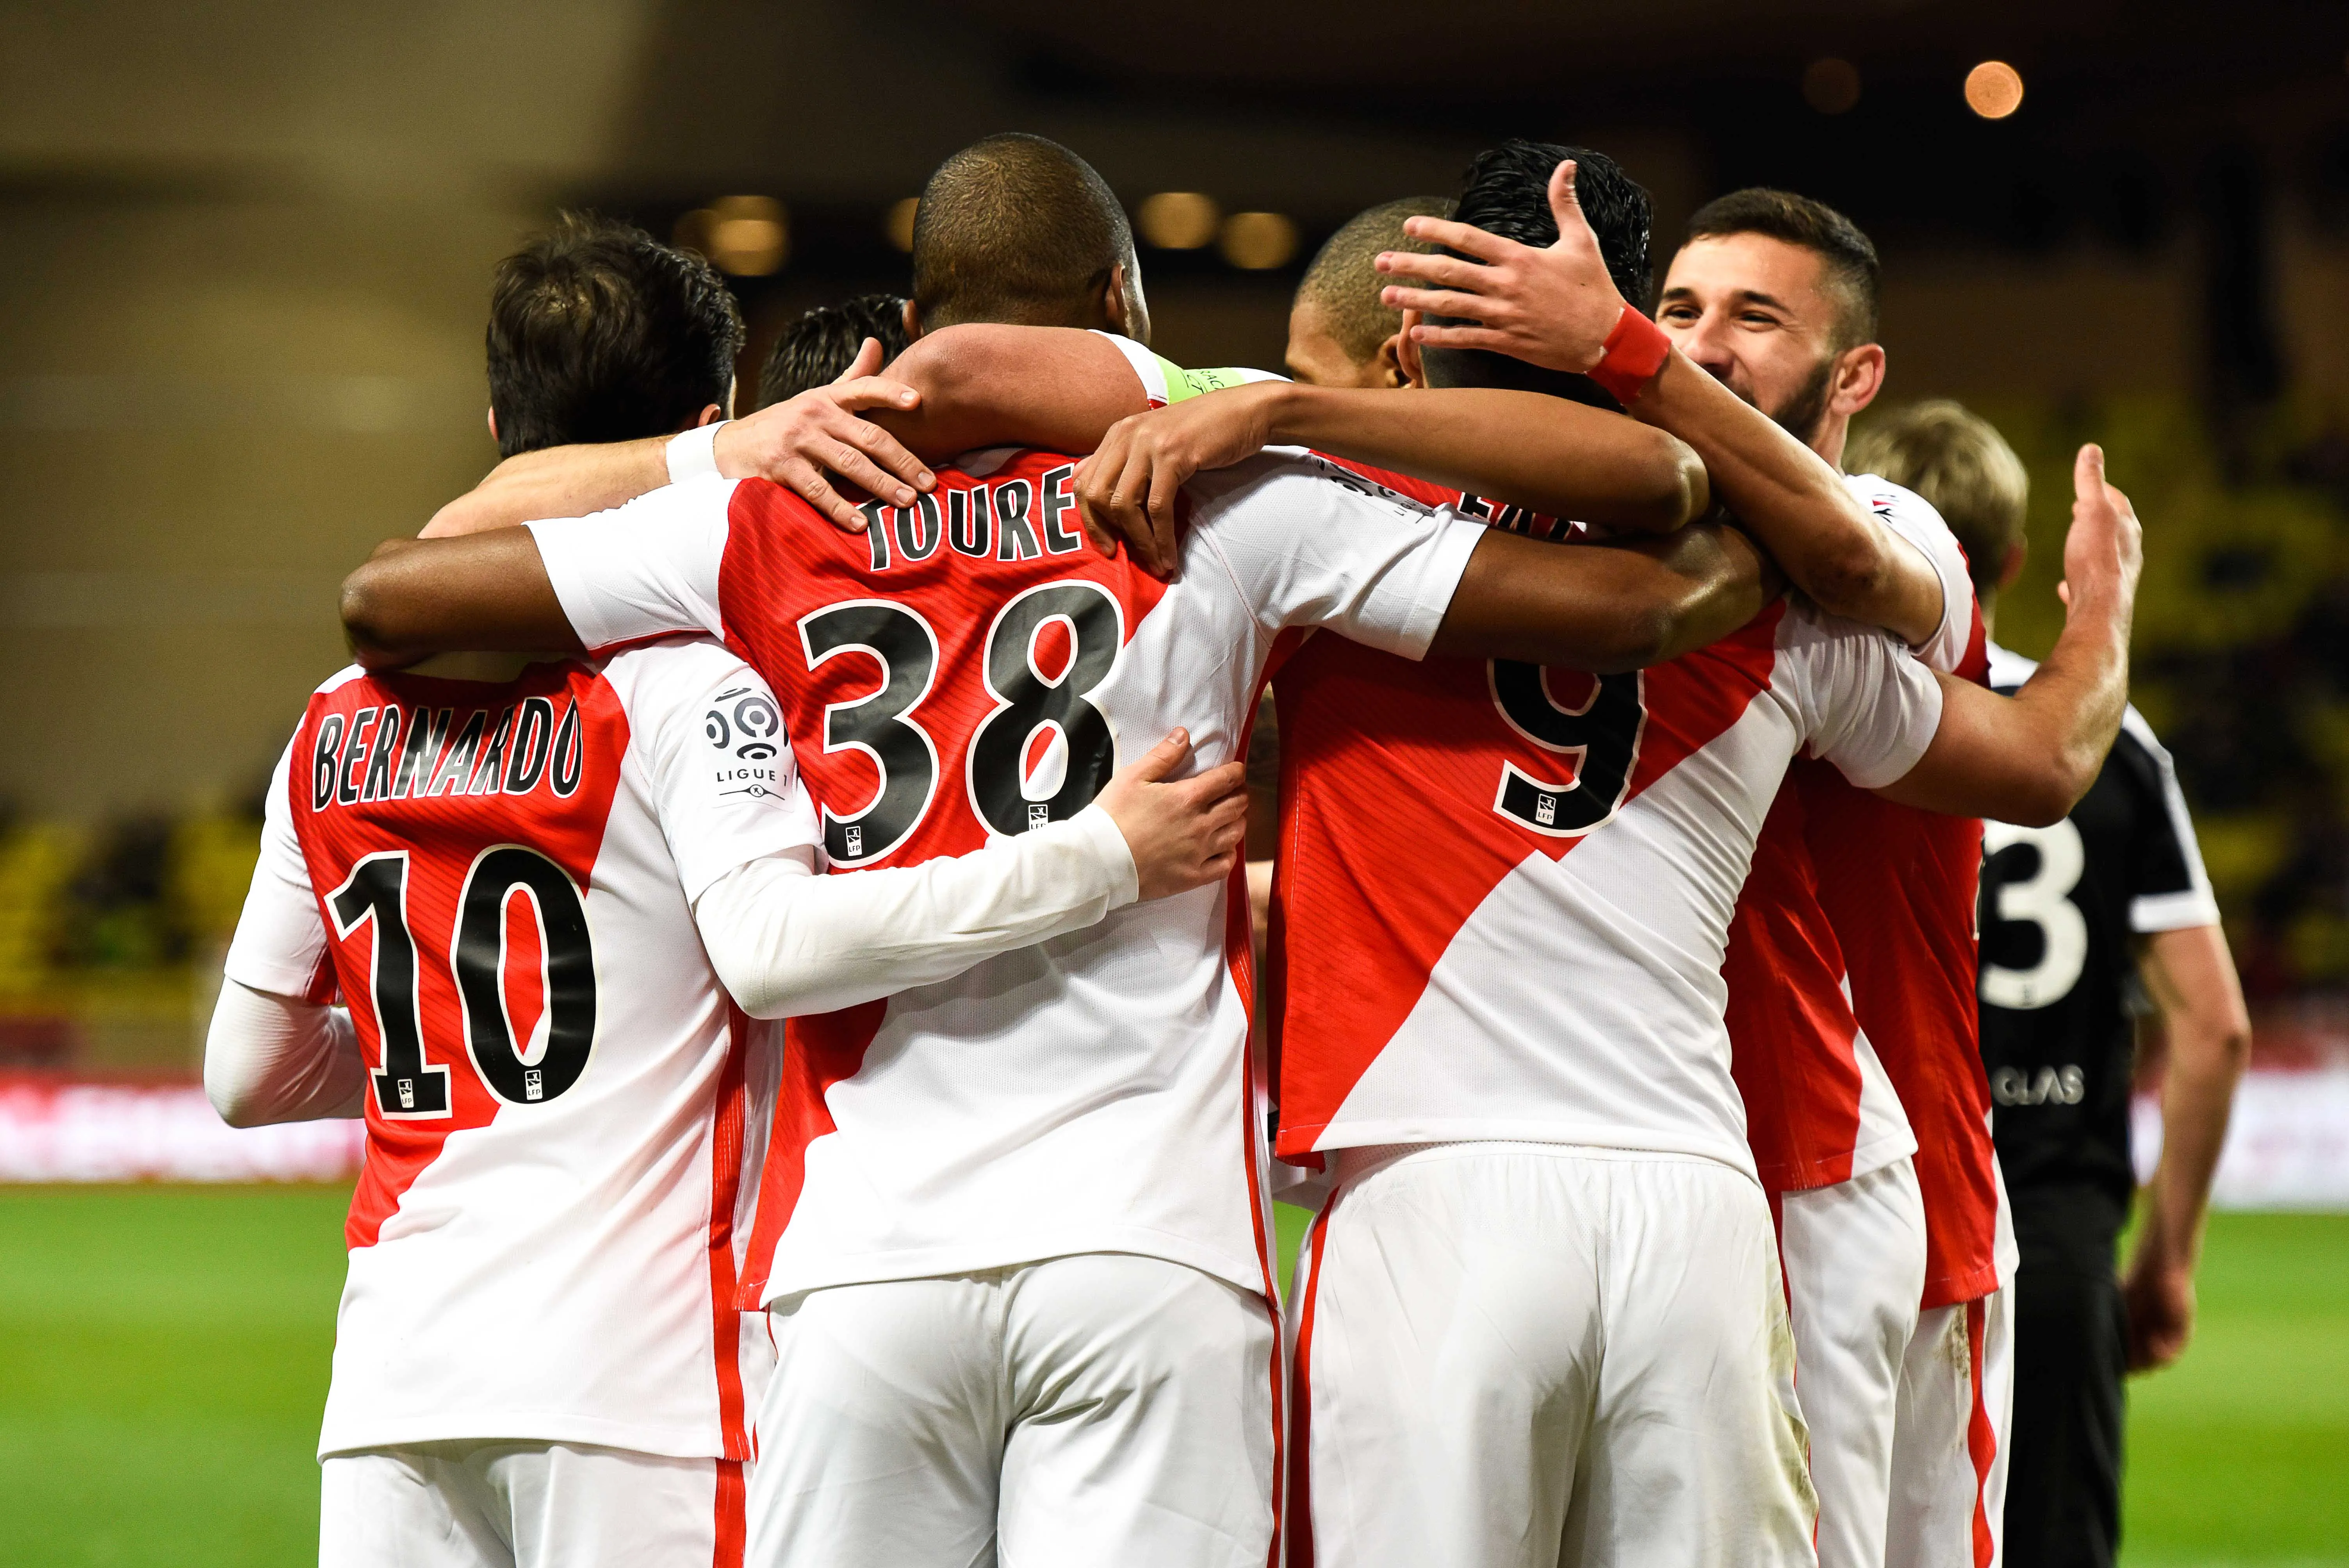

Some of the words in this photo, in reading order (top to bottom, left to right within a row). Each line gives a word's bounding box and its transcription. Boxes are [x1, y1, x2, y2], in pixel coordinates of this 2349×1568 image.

[856, 463, 1082, 572] TOURE
[314, 694, 583, 813] BERNARDO
[717, 769, 775, 782] LIGUE
[784, 775, 787, 786] 1
[797, 579, 1125, 868] 38
[1487, 658, 1648, 837] 9
[1538, 812, 1552, 820] LFP
[324, 844, 600, 1119] 10
